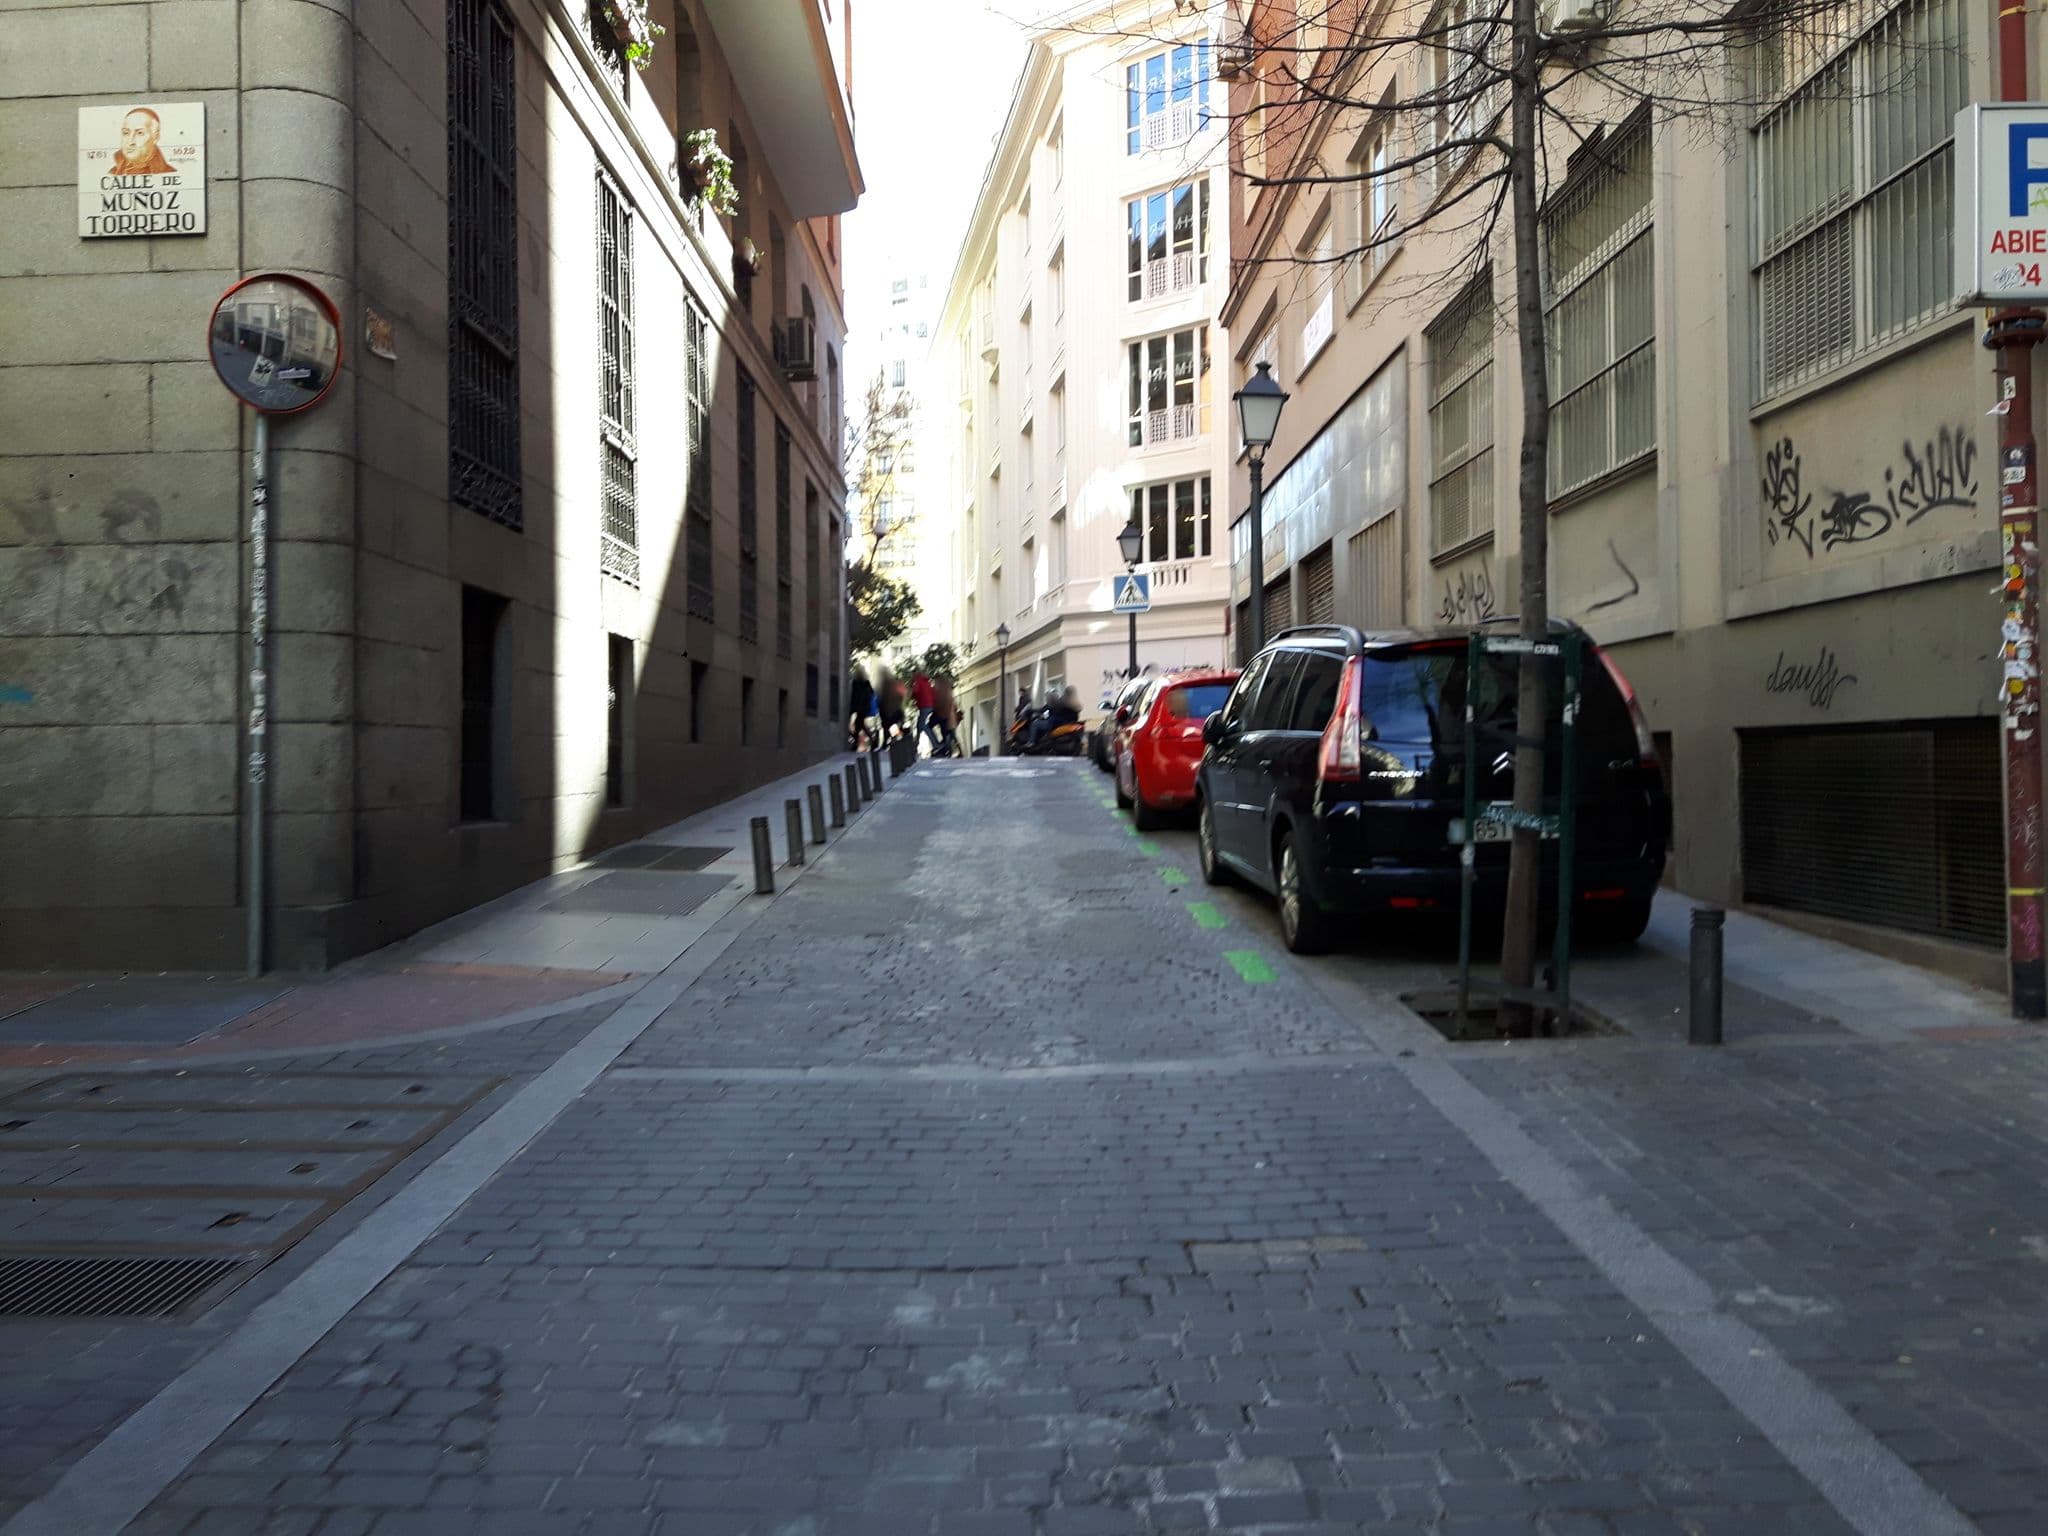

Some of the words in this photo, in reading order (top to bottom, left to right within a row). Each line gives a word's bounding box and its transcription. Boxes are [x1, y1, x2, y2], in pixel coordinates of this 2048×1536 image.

[100, 174, 155, 191] CALLE
[162, 175, 182, 187] DE
[100, 190, 181, 213] MUÑOZ
[86, 211, 196, 235] TORRERO
